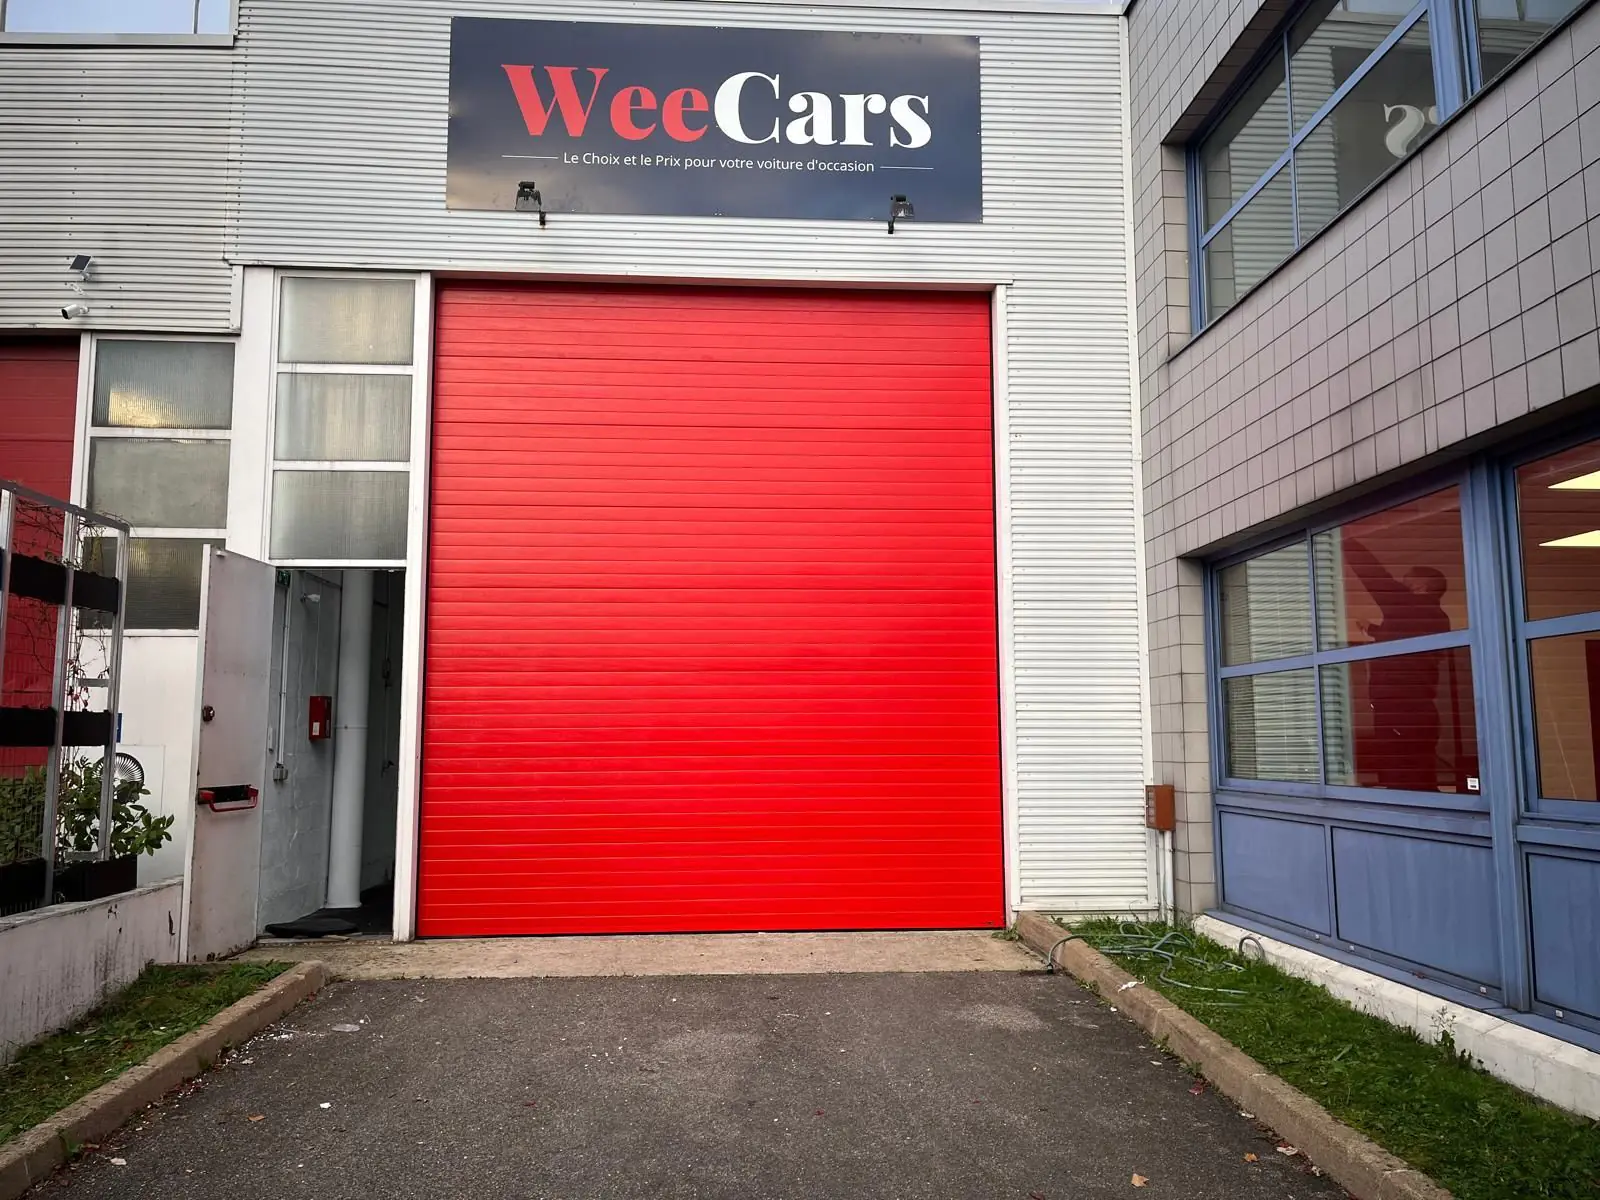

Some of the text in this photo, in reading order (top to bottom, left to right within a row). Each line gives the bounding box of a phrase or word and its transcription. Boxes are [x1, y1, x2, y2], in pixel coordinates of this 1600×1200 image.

[501, 64, 933, 149] WeeCars
[563, 152, 875, 172] Le Choix et le Prix pour votre voiture d'occasion
